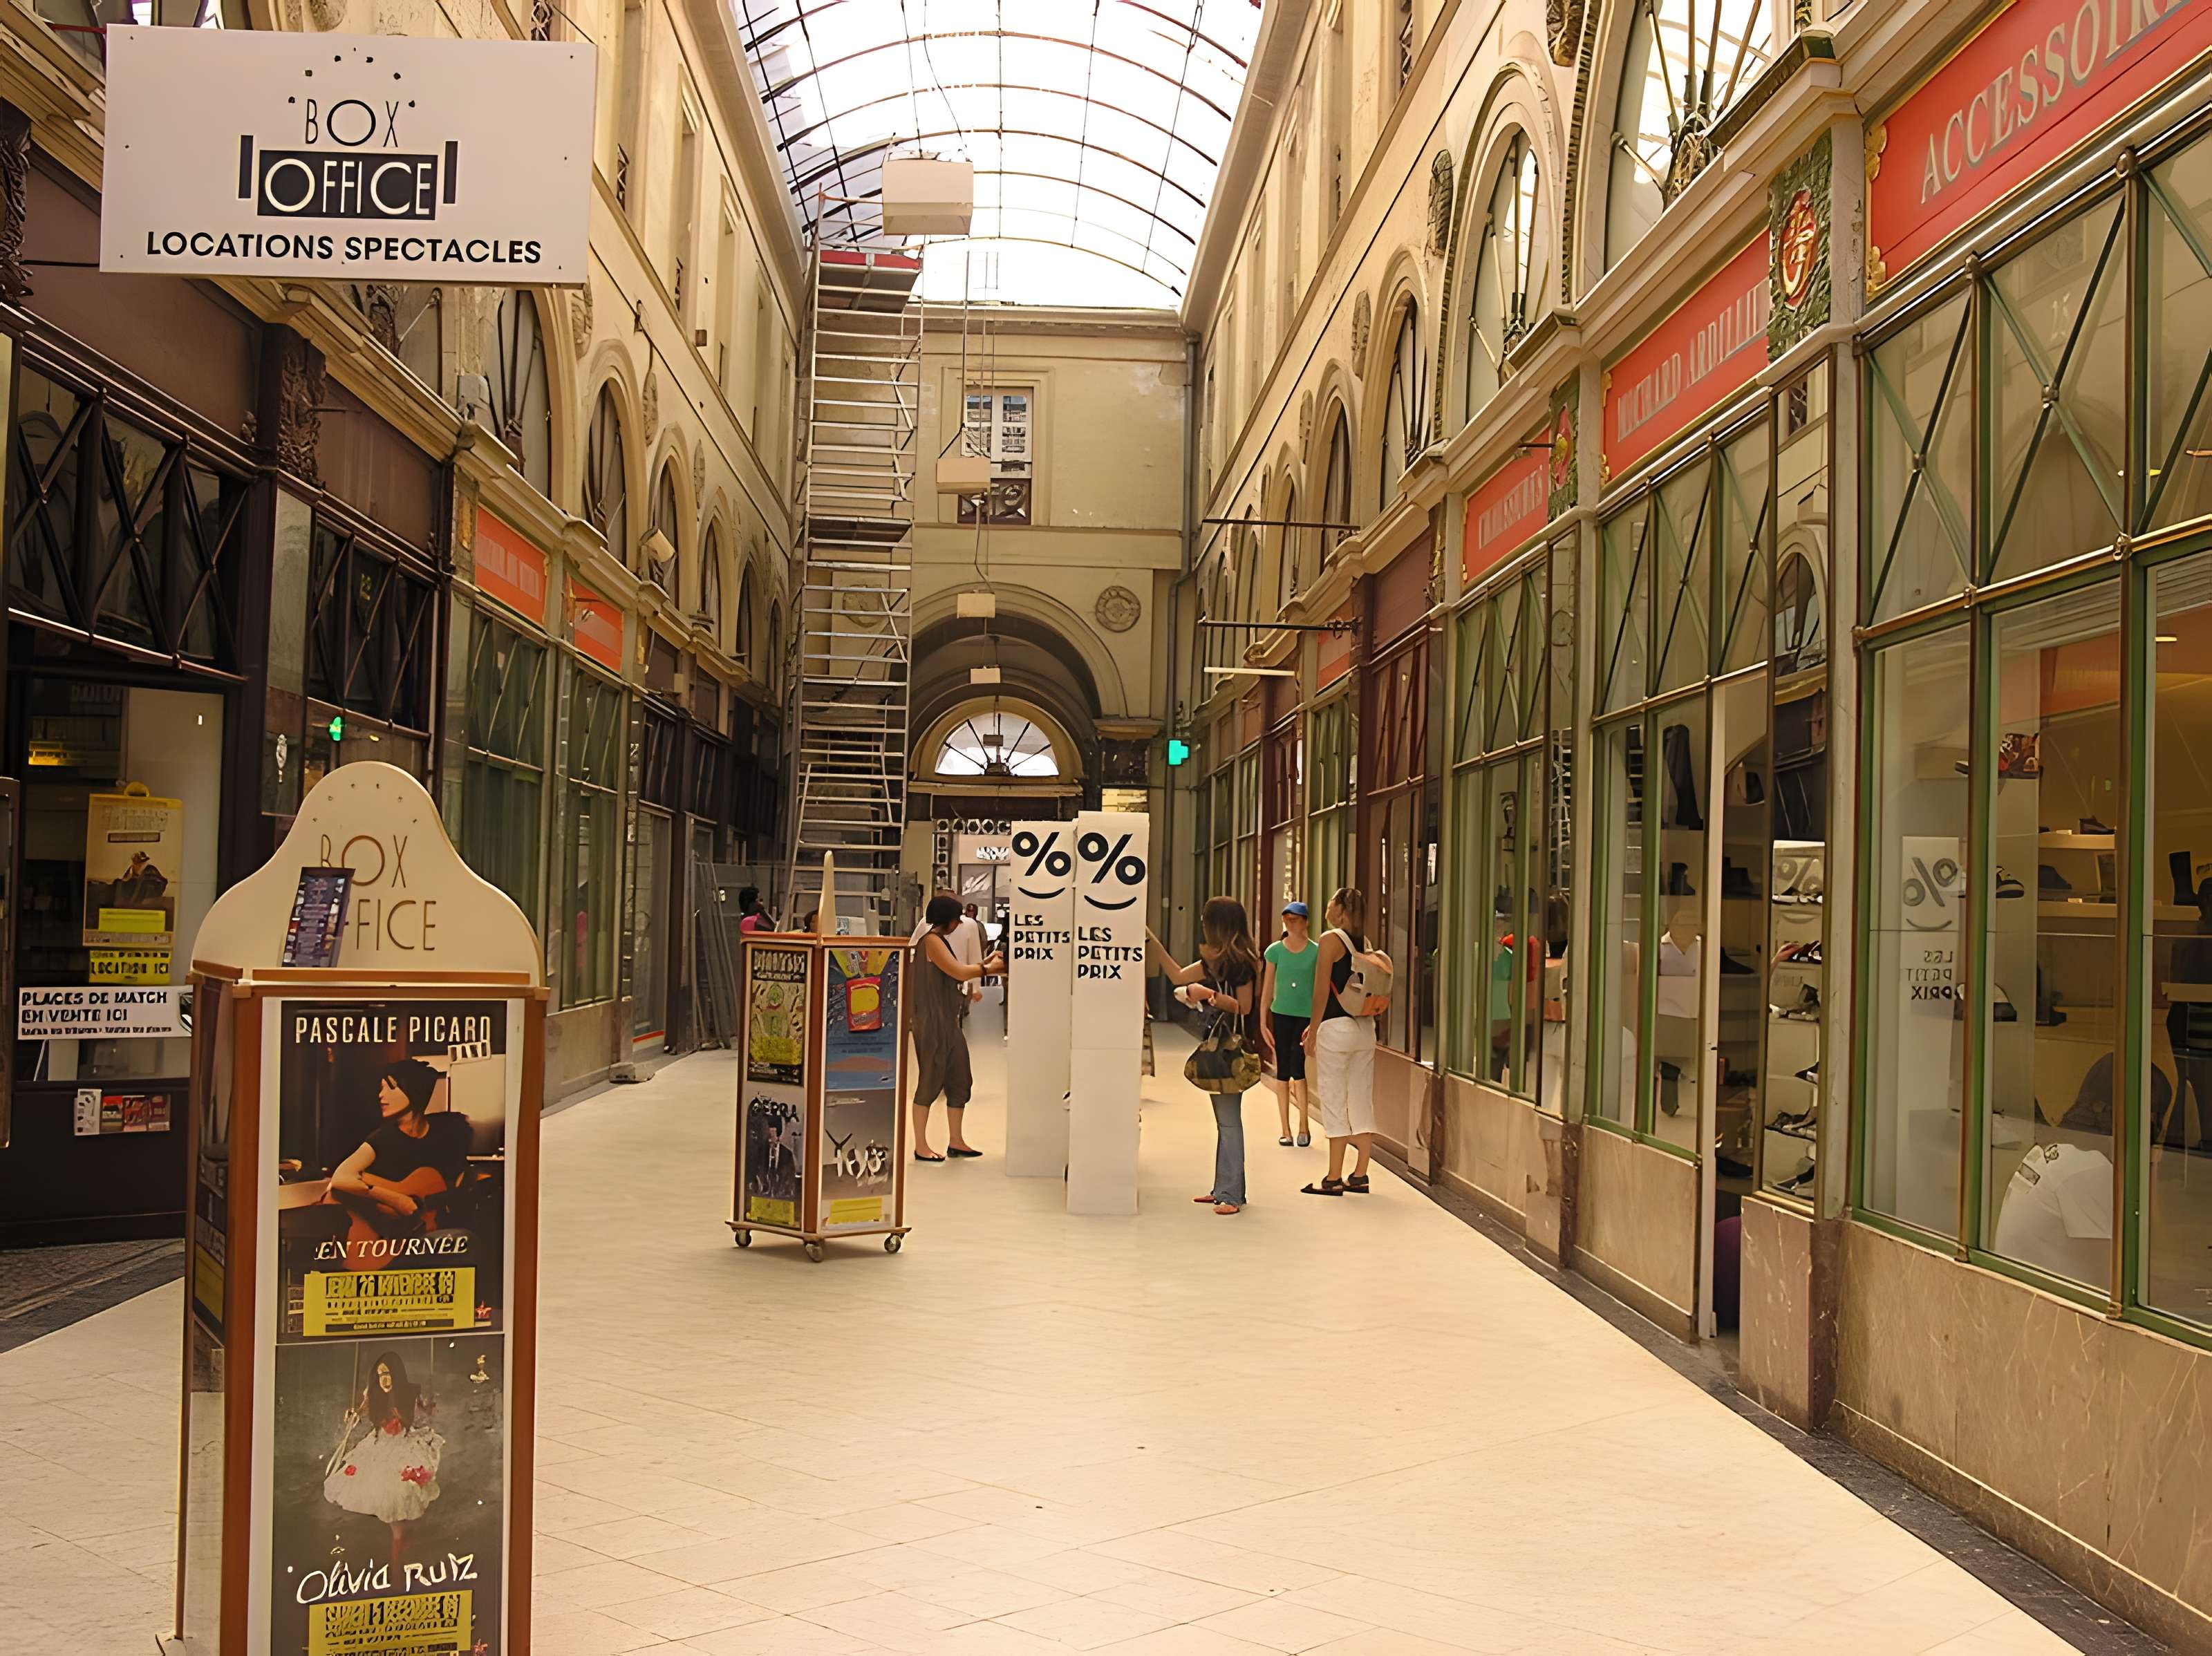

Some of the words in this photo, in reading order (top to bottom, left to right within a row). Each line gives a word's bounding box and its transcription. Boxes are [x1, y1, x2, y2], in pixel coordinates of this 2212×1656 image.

[305, 99, 399, 148] BOX
[265, 157, 433, 216] OFFICE
[146, 230, 334, 260] LOCATIONS
[344, 236, 542, 264] SPECTACLES
[345, 898, 437, 952] FICE
[1014, 914, 1043, 926] LES
[1014, 931, 1070, 943] PETITS
[1078, 926, 1112, 941] LES
[1014, 948, 1053, 960] PRIX
[1078, 946, 1143, 961] PETITS
[1078, 965, 1122, 979] PRIX
[21, 992, 84, 1006] PLACES
[88, 992, 109, 1005] DE
[114, 991, 167, 1004] MATCH
[295, 1016, 397, 1043] PASCALE
[409, 1016, 491, 1043] PICARD
[314, 1239, 350, 1261] EN
